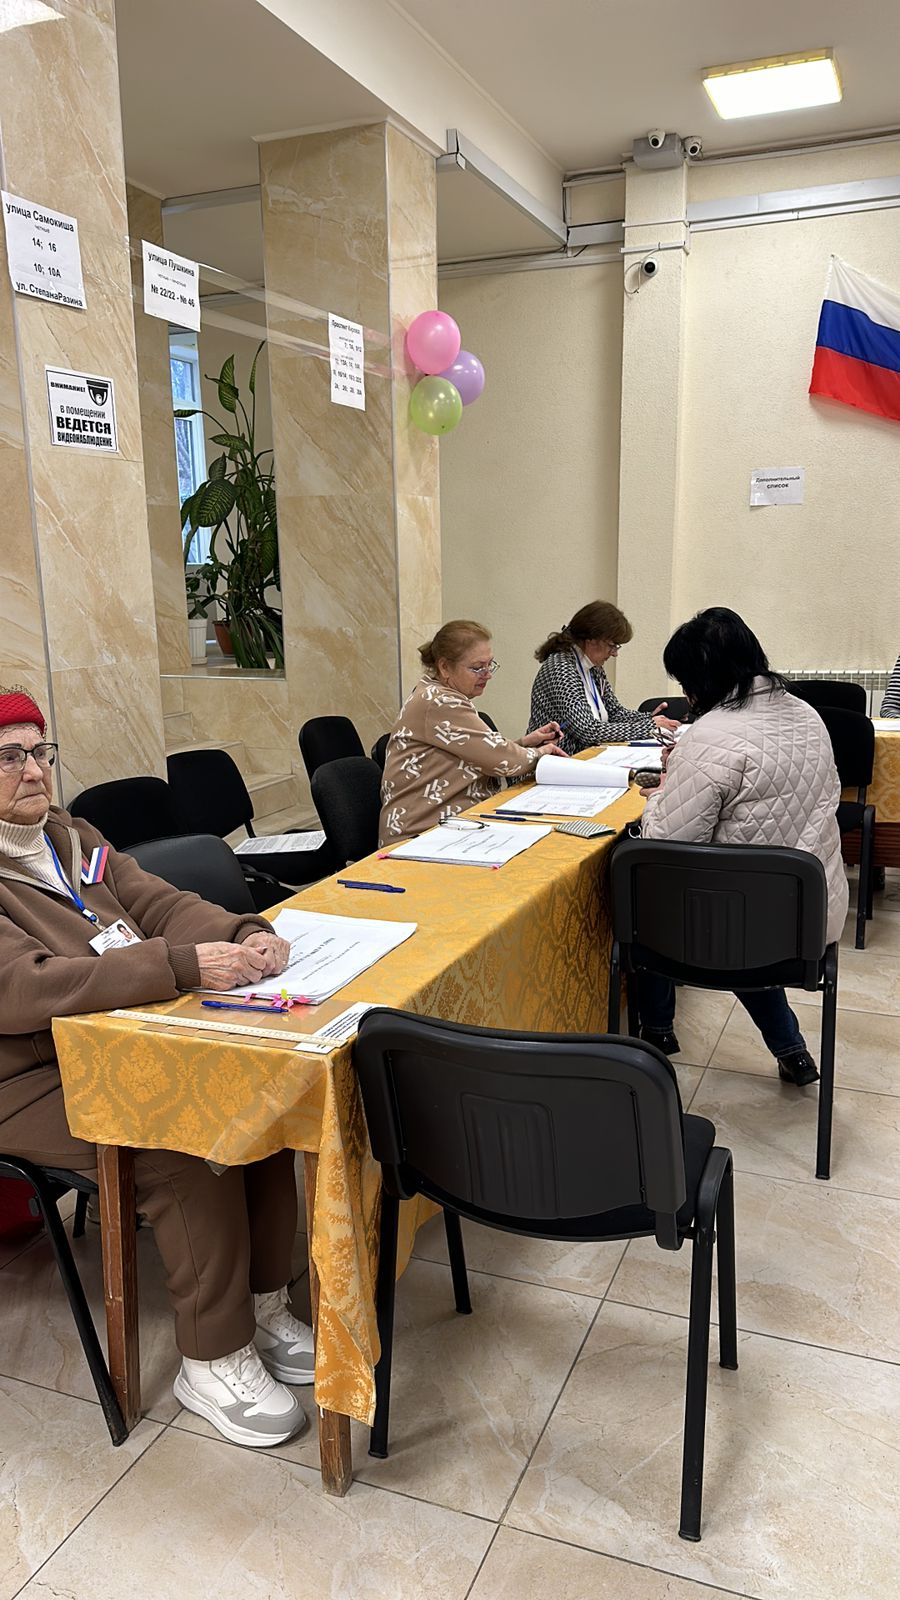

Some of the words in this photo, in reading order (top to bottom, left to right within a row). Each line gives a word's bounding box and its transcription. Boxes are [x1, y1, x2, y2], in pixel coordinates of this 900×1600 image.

[6, 203, 31, 219] улица
[33, 210, 74, 232] Самокиша
[32, 237, 43, 250] 14;
[48, 242, 57, 252] 16
[33, 263, 45, 275] 10;
[148, 252, 167, 266] улица
[168, 259, 195, 277] Пушкина
[16, 281, 28, 291] ул.
[151, 283, 159, 294] №
[180, 295, 187, 305] №
[50, 382, 86, 393] ВНИМАНИЕ!
[66, 406, 106, 419] помещении
[56, 416, 111, 435] ВЕДЕТСЯ
[57, 432, 113, 447] ВИДЕОНАБЛЮДЕНИЕ
